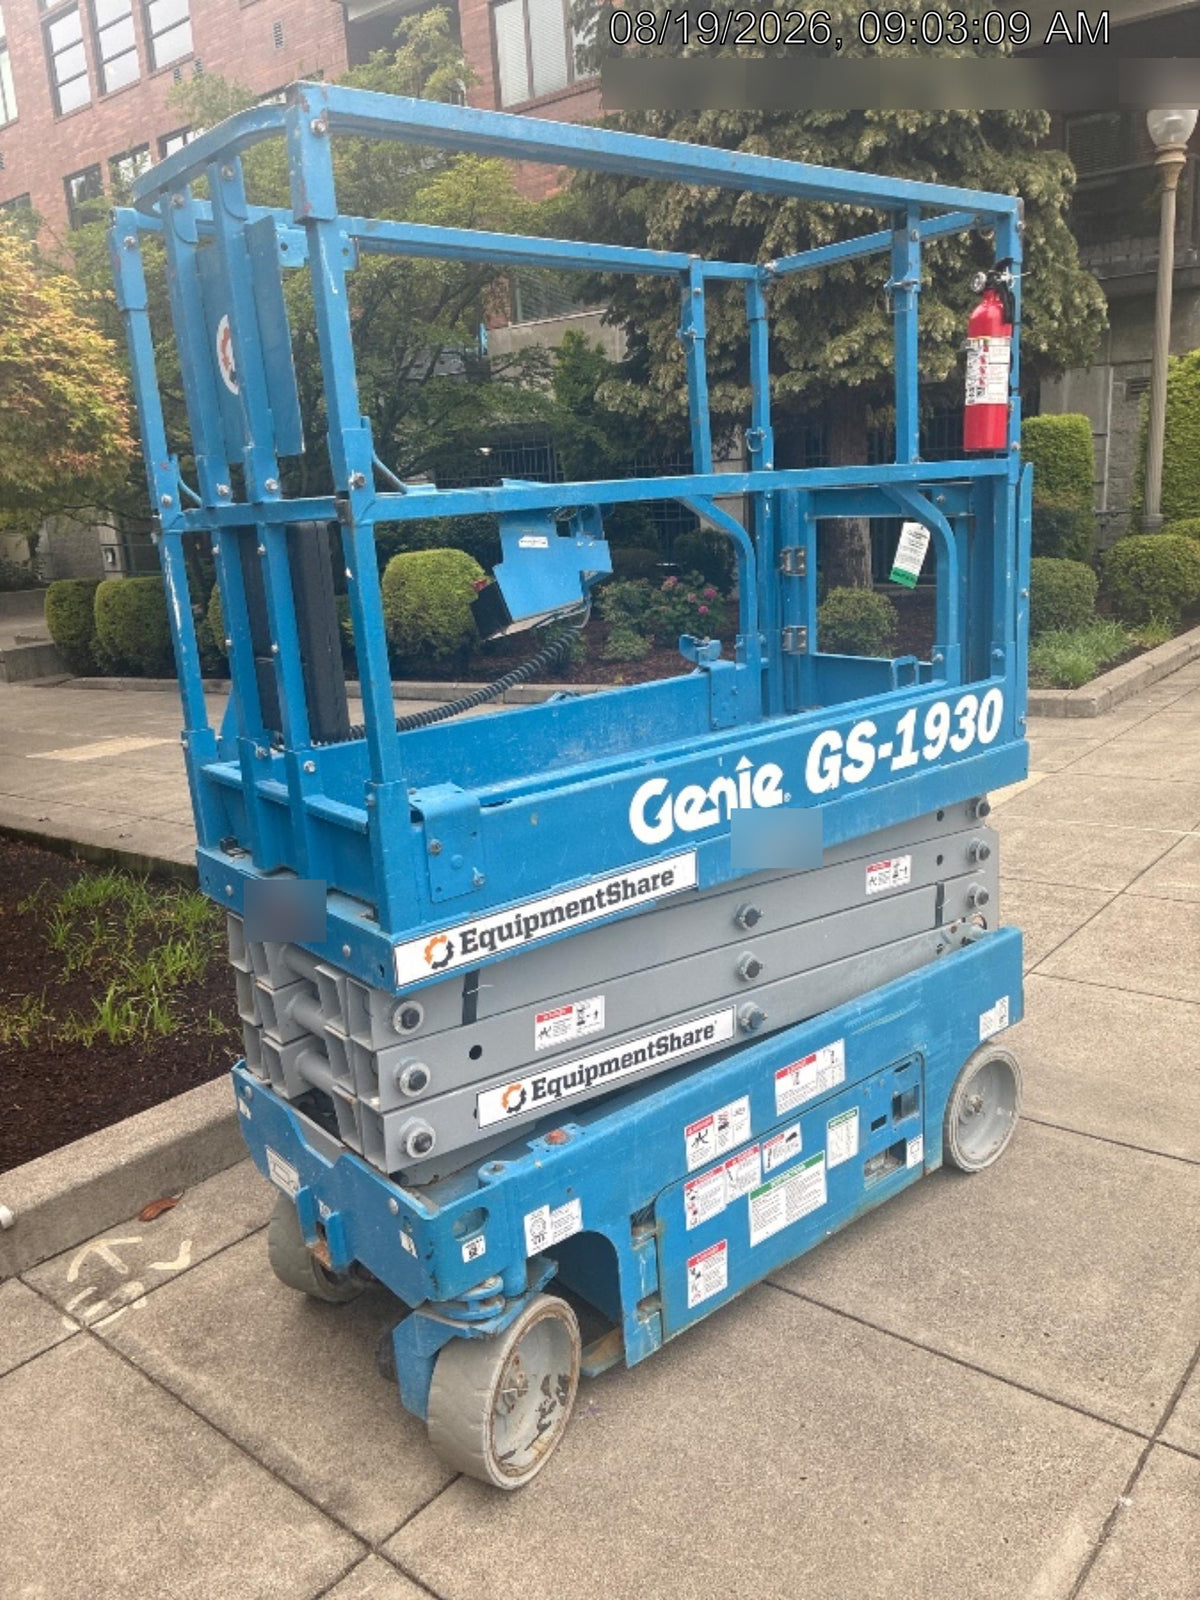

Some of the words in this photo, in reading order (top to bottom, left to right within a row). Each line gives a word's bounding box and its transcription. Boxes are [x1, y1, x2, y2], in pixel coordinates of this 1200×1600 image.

[628, 754, 785, 845] Genie
[804, 687, 1003, 795] GS-1930
[458, 867, 676, 955] EquipmentShare
[530, 1023, 716, 1101] EquipmentShare
